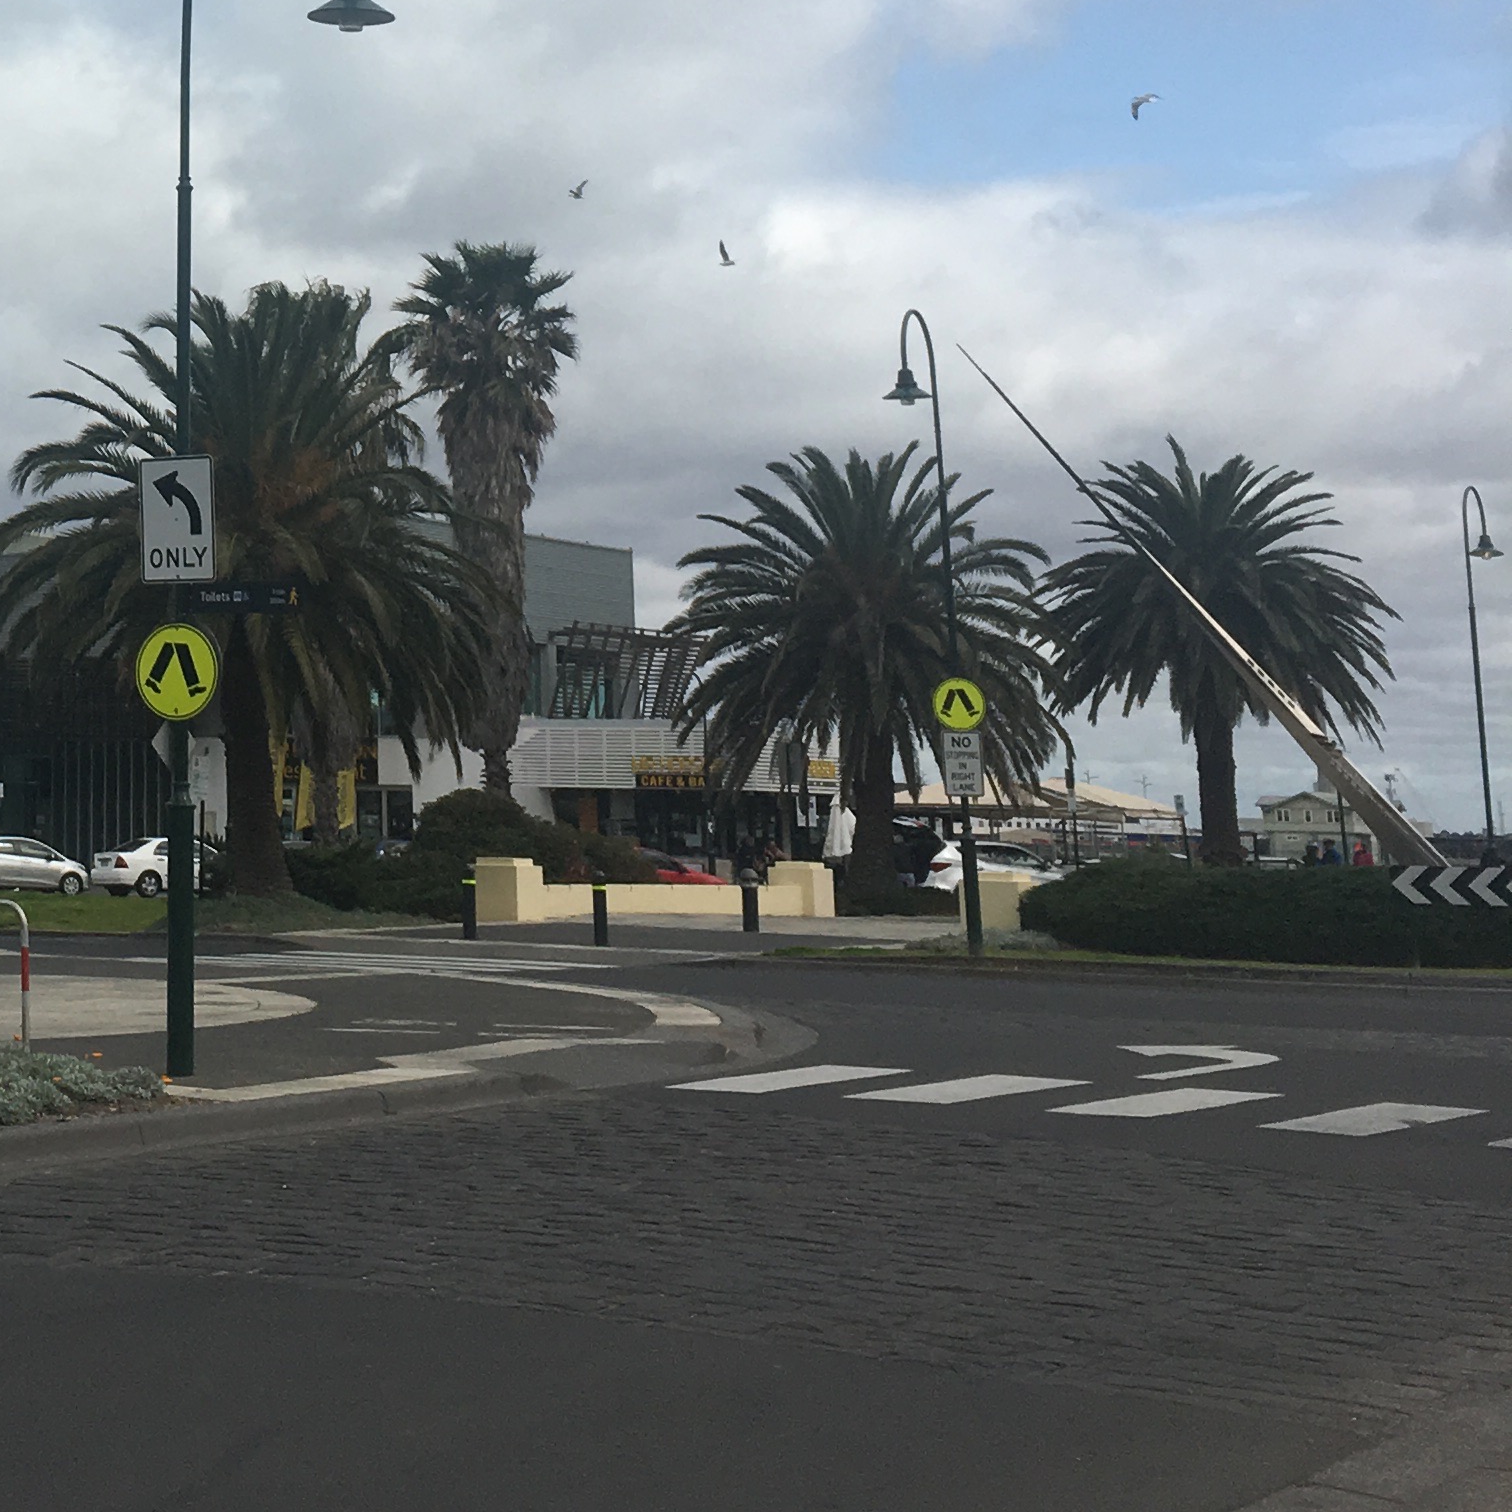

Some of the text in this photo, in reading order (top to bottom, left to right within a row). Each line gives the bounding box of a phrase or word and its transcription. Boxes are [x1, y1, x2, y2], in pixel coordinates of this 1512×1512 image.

[149, 546, 208, 568] ONLY
[200, 591, 231, 603] Toilets
[951, 736, 972, 748] NO
[958, 761, 968, 770] IN
[640, 775, 674, 787] CAFE
[688, 775, 706, 787] BA
[951, 772, 976, 781] RIGHT
[952, 783, 976, 792] LANE
